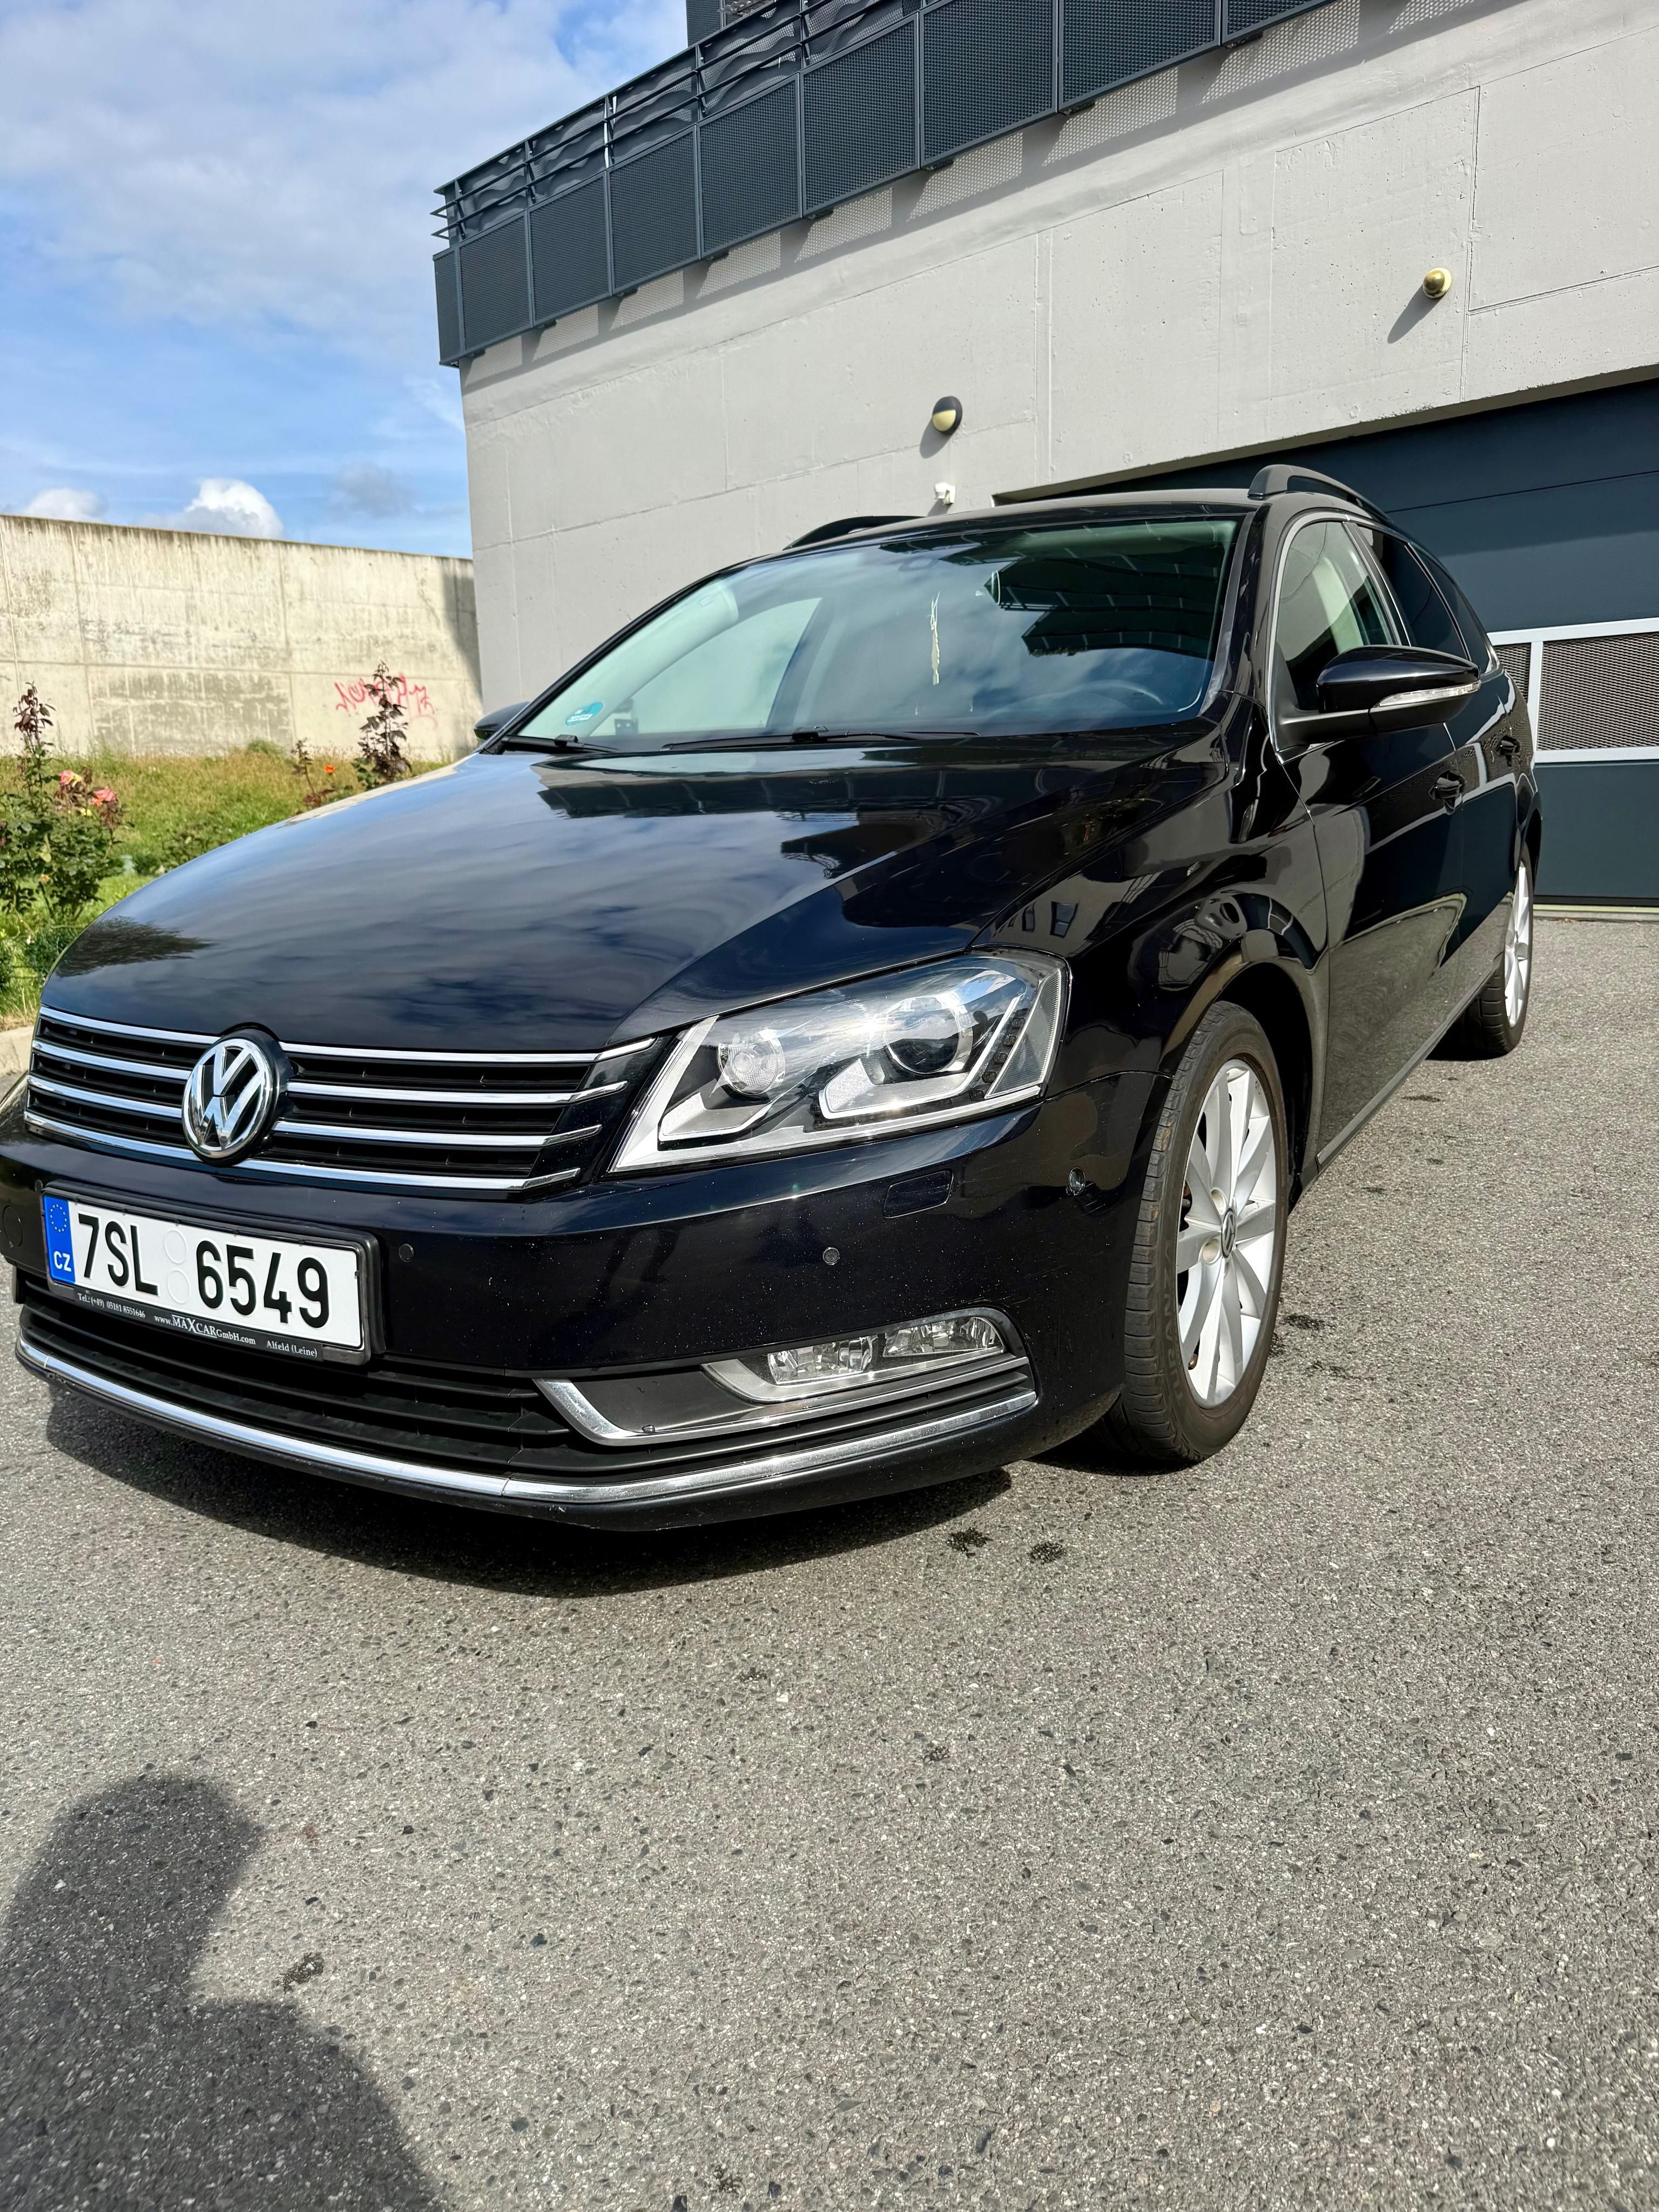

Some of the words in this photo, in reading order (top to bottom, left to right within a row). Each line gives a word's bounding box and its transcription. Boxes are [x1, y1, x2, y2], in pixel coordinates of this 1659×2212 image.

[54, 1250, 72, 1272] CZ
[78, 1213, 158, 1296] 7SL
[196, 1240, 330, 1328] 6549
[267, 1340, 290, 1352] Alfeld
[292, 1344, 318, 1358] (Leine)
